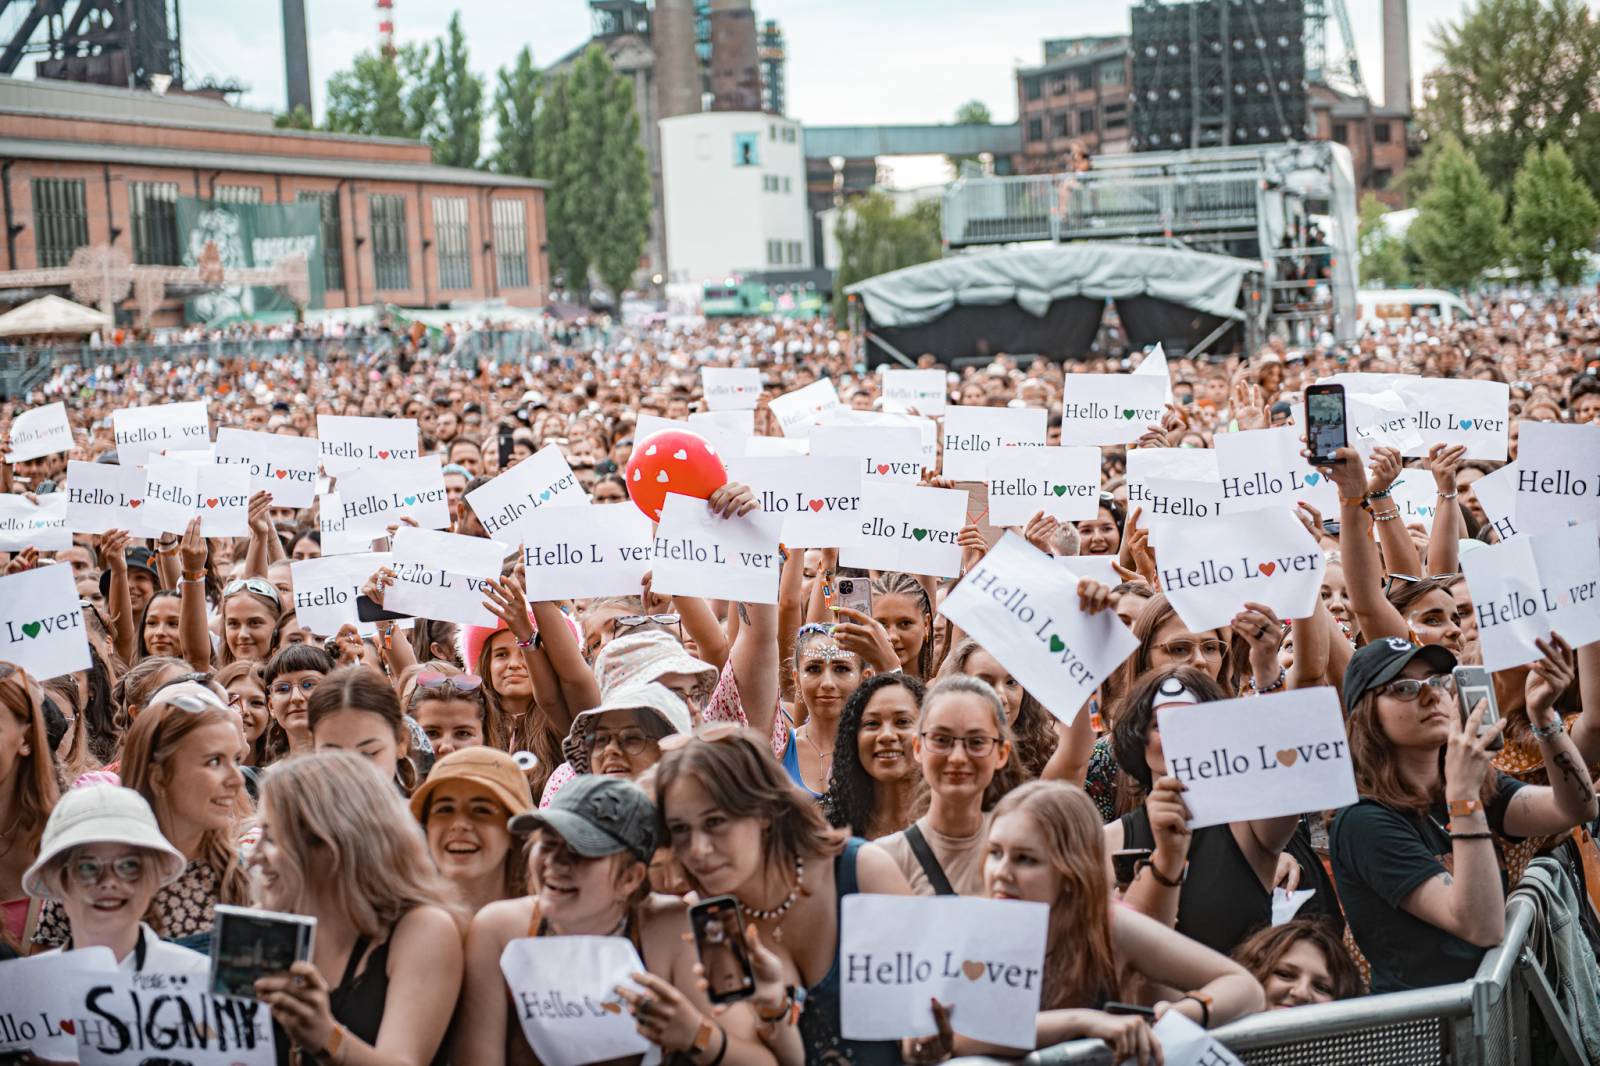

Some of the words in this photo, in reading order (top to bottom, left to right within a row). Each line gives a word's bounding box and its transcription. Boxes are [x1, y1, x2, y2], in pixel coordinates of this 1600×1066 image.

[1066, 403, 1108, 420] Hello
[1411, 411, 1441, 429] llo
[116, 429, 157, 445] Hello
[946, 434, 990, 451] Hello
[321, 442, 363, 458] Hello
[992, 478, 1037, 497] Hello
[1222, 472, 1283, 499] Hello
[1518, 469, 1587, 496] Hello
[69, 488, 114, 506] Hello
[147, 482, 191, 506] Hello
[758, 492, 789, 513] llo
[343, 496, 388, 519] Hello
[1152, 496, 1208, 518] Hello
[0, 518, 24, 530] ello
[321, 517, 345, 533] Hel
[862, 518, 895, 538] ello
[525, 543, 583, 568] Hello
[655, 537, 707, 563] Hello
[1162, 559, 1234, 592] Hello
[297, 586, 347, 608] Hello
[970, 568, 1034, 624] Hello
[1477, 591, 1537, 628] Hello
[1171, 748, 1249, 782] Hello
[848, 951, 932, 985] Hello
[520, 991, 583, 1020] Hello
